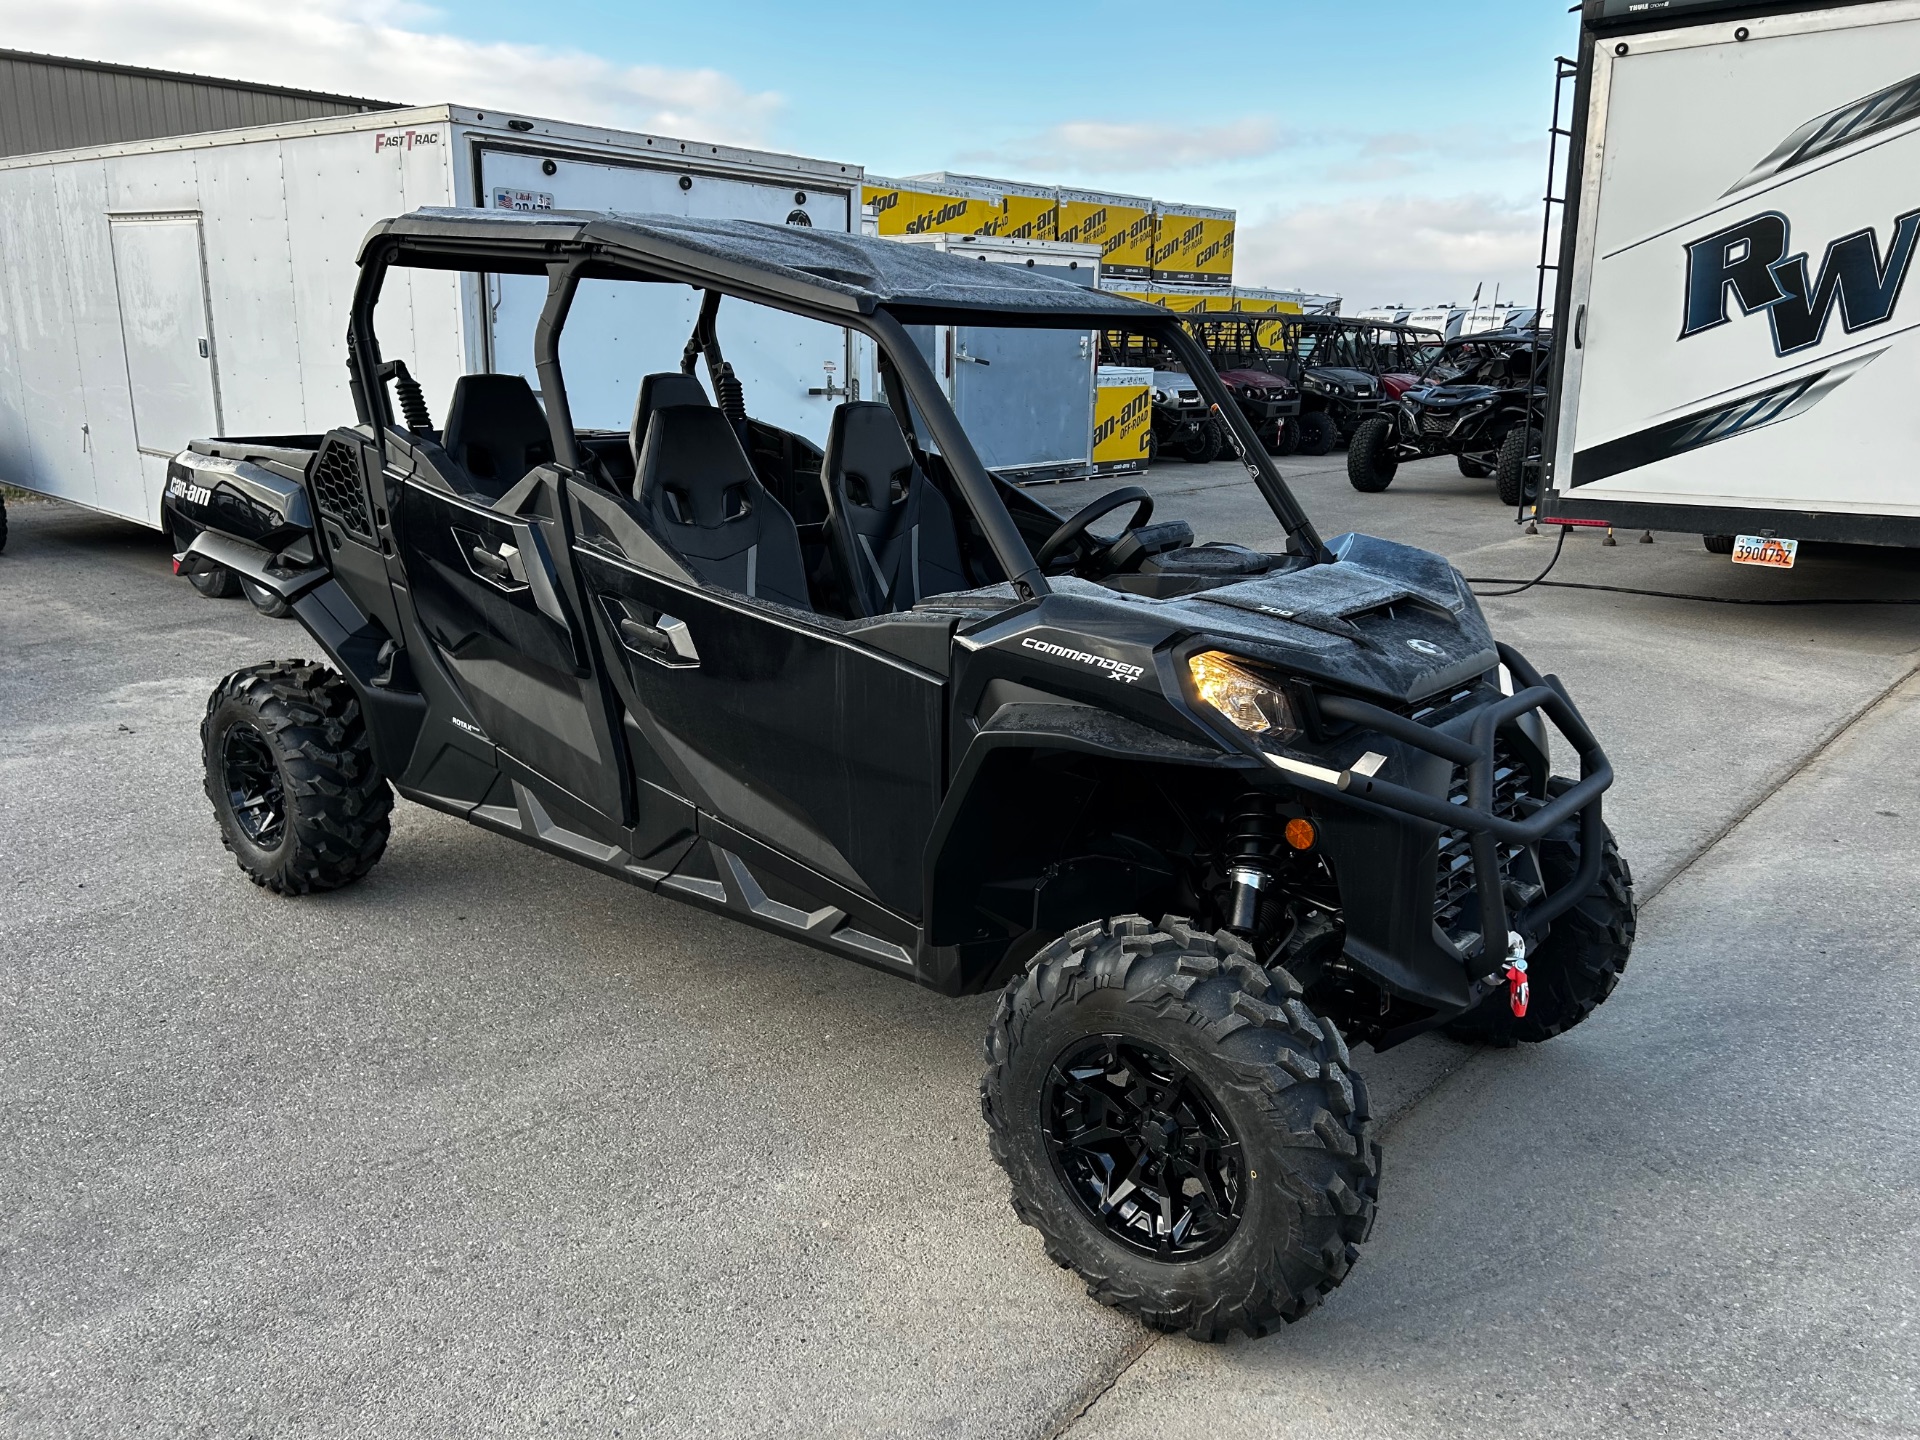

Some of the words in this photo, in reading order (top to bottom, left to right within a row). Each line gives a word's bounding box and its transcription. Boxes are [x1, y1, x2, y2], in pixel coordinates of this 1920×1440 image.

[905, 200, 968, 235] ski-doo
[1154, 220, 1204, 266] can-am
[1120, 409, 1149, 440] OFF-ROAD
[170, 476, 211, 507] can-am
[1736, 545, 1792, 564] 390075Z
[1257, 604, 1294, 616] 700
[1021, 637, 1145, 677] COMMANDER
[1107, 670, 1139, 684] XT
